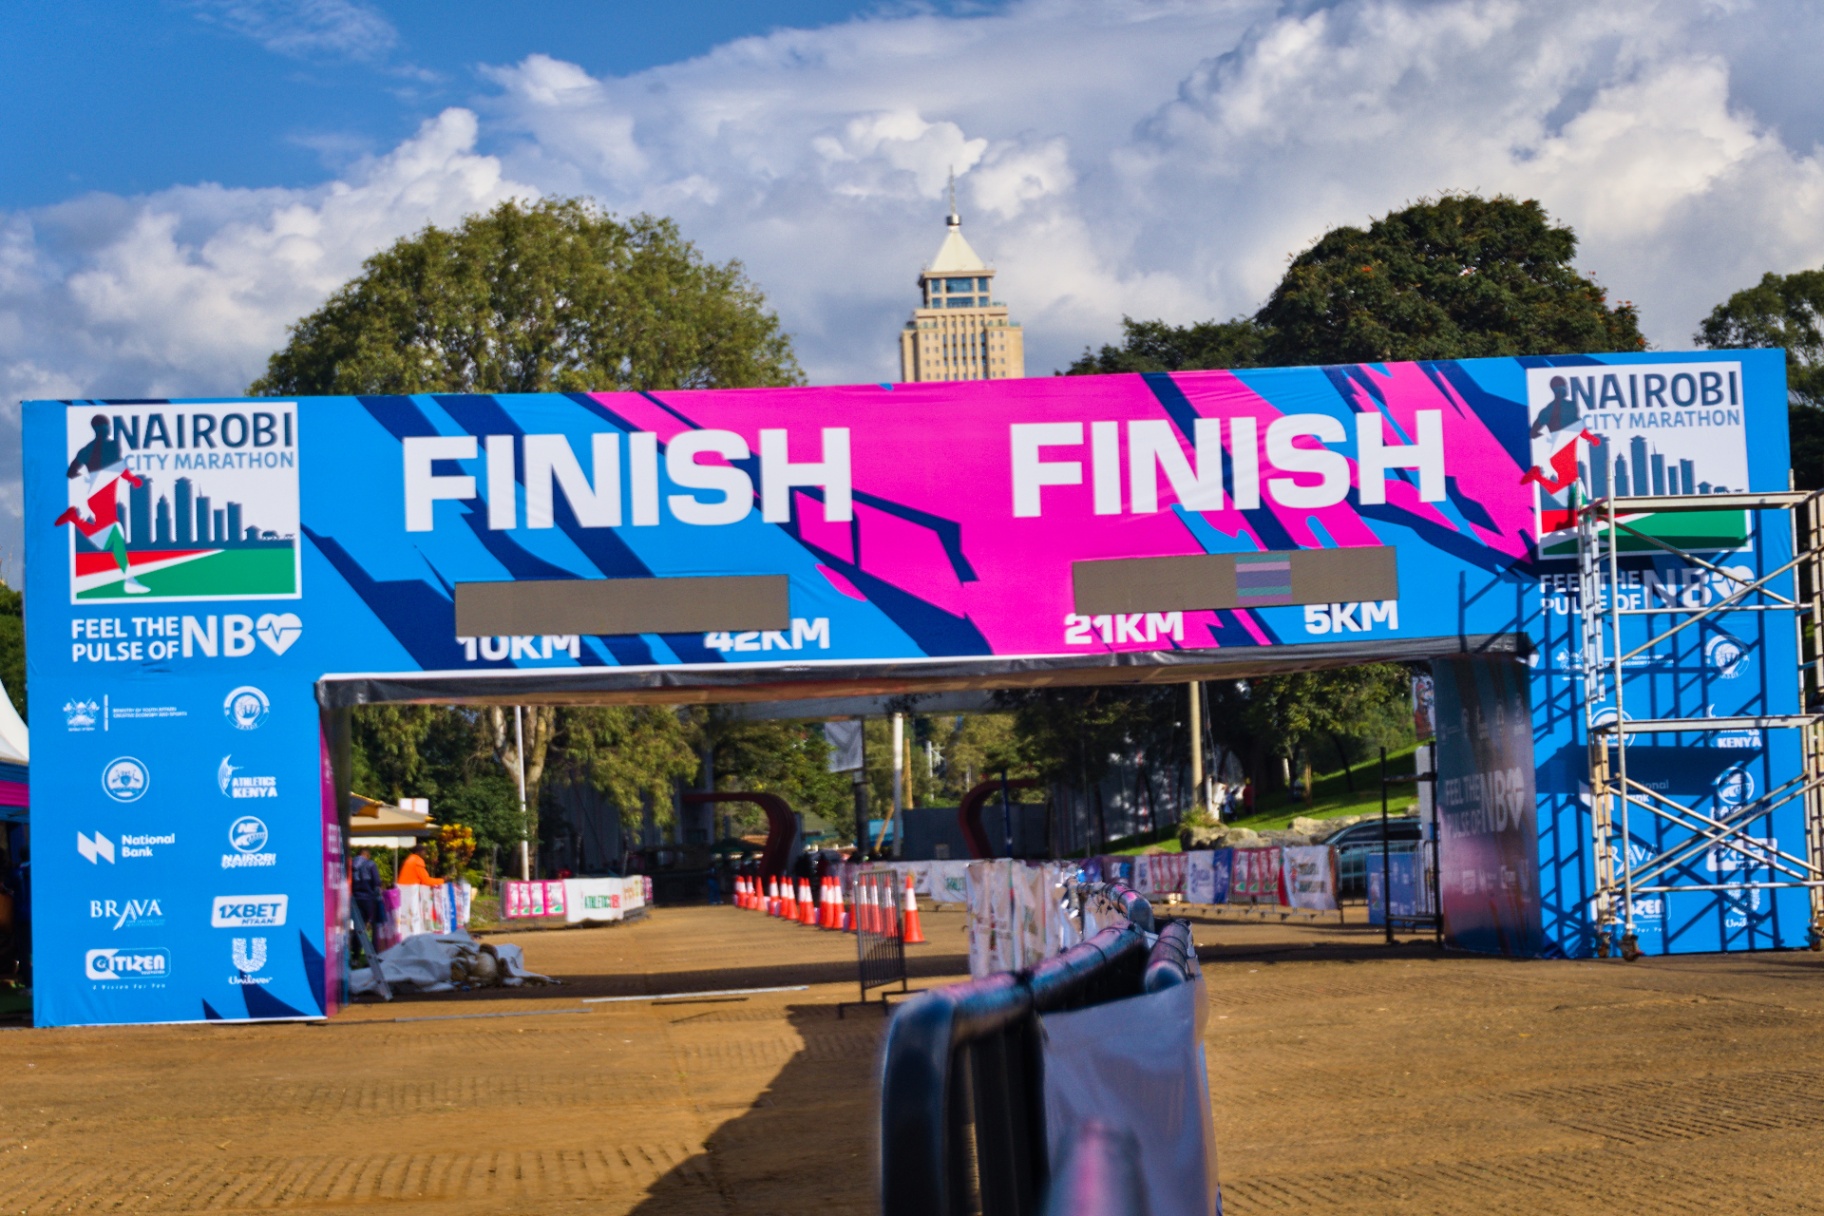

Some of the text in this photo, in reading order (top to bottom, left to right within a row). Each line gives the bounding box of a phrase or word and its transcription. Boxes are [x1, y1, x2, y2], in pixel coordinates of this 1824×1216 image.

[1569, 371, 1740, 410] NAIROBI
[112, 412, 293, 450] NAIROBI
[1583, 409, 1740, 431] CITY MARATHON
[124, 452, 294, 471] CITY MARATHON
[1010, 409, 1447, 518] FINISH
[402, 427, 853, 532] FINISH
[1539, 573, 1580, 594] FEE
[72, 616, 179, 639] FEEL THE
[1064, 612, 1184, 645] 21KM
[1304, 599, 1399, 635] 5KM
[182, 614, 256, 658] NB
[703, 617, 830, 652] 42KM
[72, 640, 180, 662] PULSE OF
[456, 634, 581, 662] 10KM
[1717, 736, 1763, 749] KENYA
[232, 787, 278, 798] KENYA
[122, 833, 175, 845] National
[122, 846, 153, 858] Bank
[222, 853, 277, 863] NAIROBI
[90, 899, 163, 931] BRAVA
[219, 903, 282, 919] 1XBET
